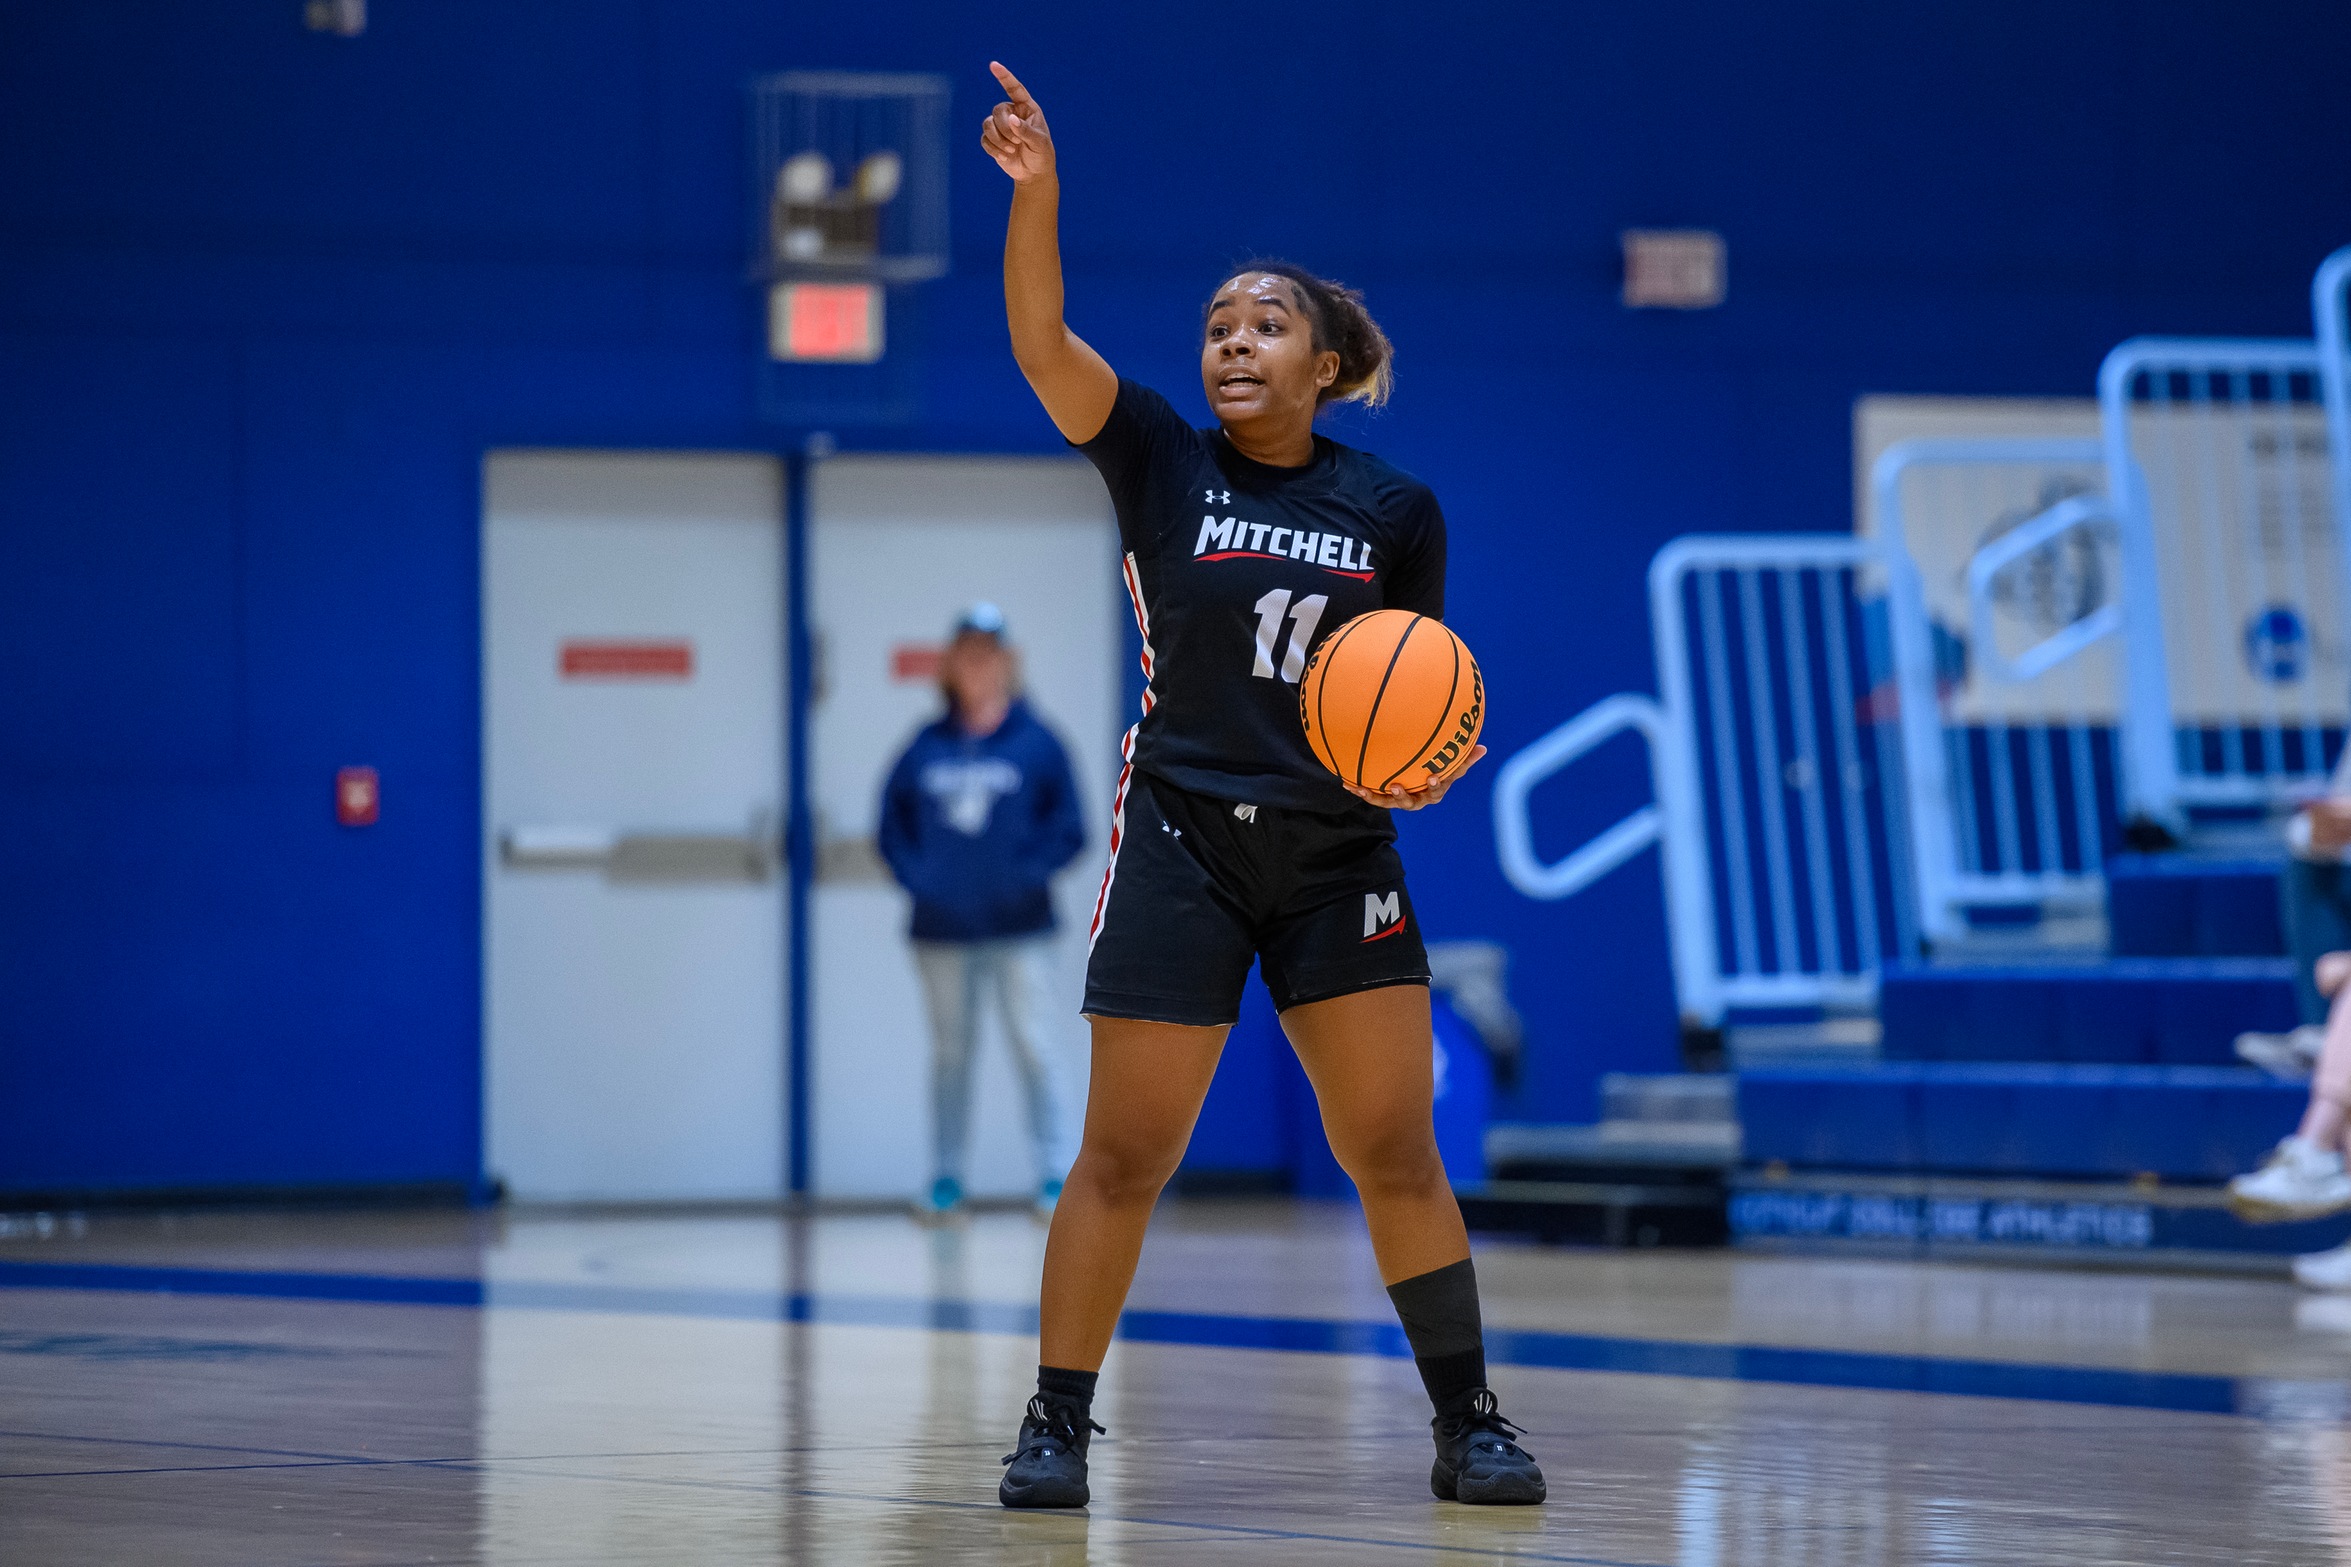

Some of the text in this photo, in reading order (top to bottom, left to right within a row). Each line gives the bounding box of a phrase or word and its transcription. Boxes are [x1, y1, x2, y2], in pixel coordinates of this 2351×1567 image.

[1193, 515, 1375, 571] MITCHELL
[1252, 588, 1329, 684] 11
[1421, 659, 1482, 774] Wilson
[1363, 891, 1401, 938] M
